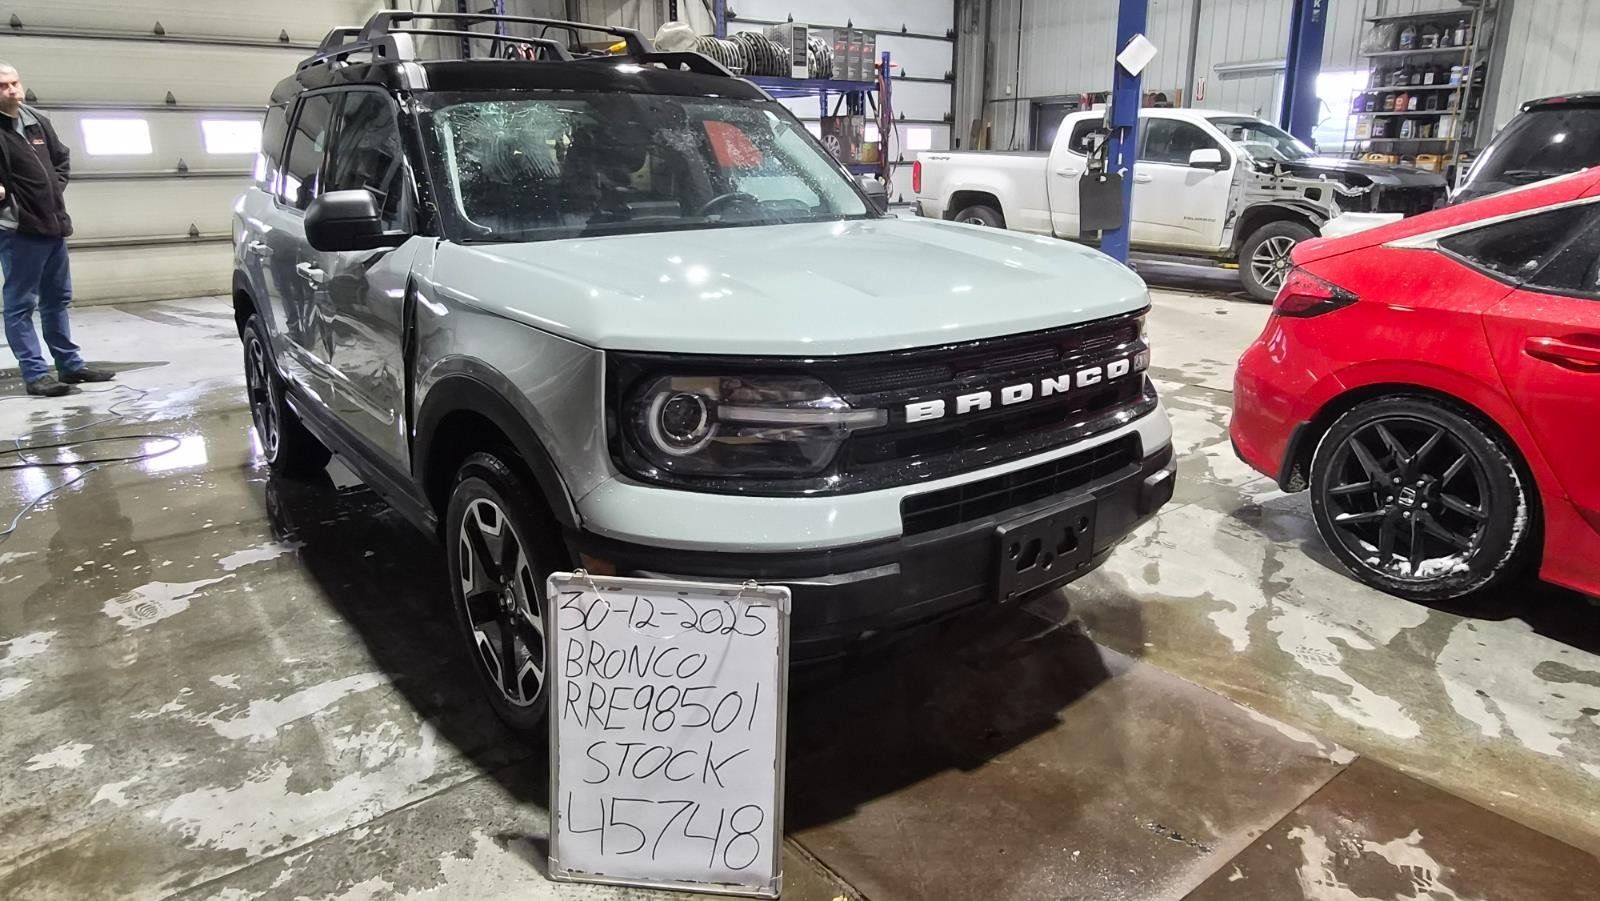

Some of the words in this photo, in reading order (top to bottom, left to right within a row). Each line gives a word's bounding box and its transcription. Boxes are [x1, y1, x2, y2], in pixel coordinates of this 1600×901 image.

[905, 358, 1130, 424] BRONCO
[559, 590, 771, 637] 30-12-2025
[565, 638, 708, 679] BRONCO
[563, 682, 760, 734] RRE98501
[582, 740, 751, 788] STOCK
[567, 791, 765, 871] 45748
